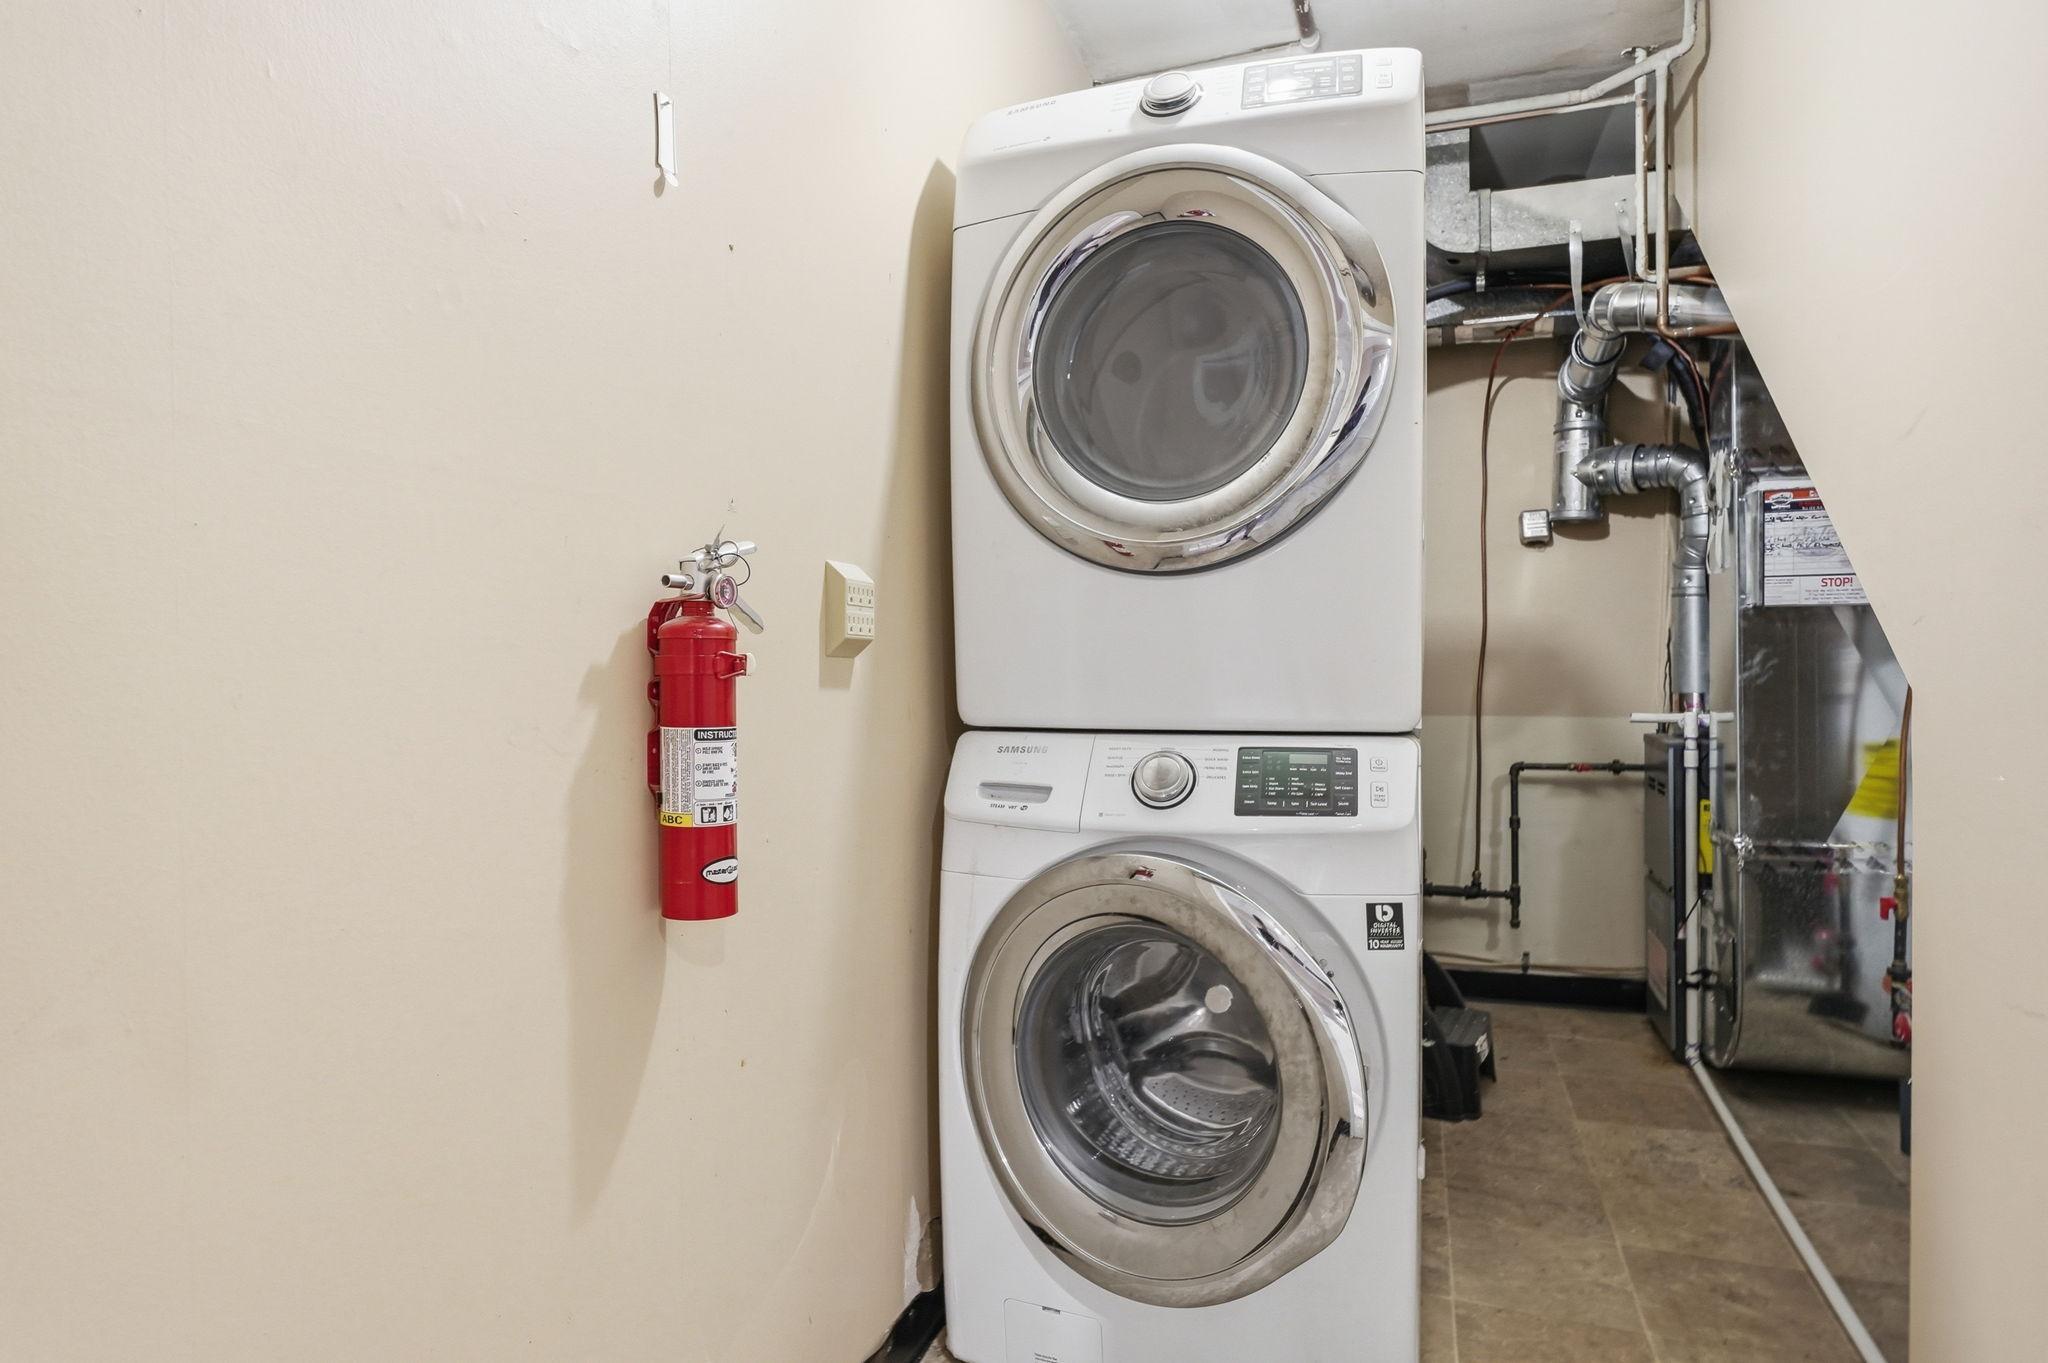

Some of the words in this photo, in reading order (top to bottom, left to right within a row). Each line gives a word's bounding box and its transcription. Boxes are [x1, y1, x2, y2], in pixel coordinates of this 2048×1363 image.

[1007, 100, 1056, 116] SAMSUNG
[1821, 577, 1853, 587] STOP!
[996, 745, 1048, 754] SAMSUNG
[662, 814, 683, 825] ABC
[1368, 939, 1380, 949] 10
